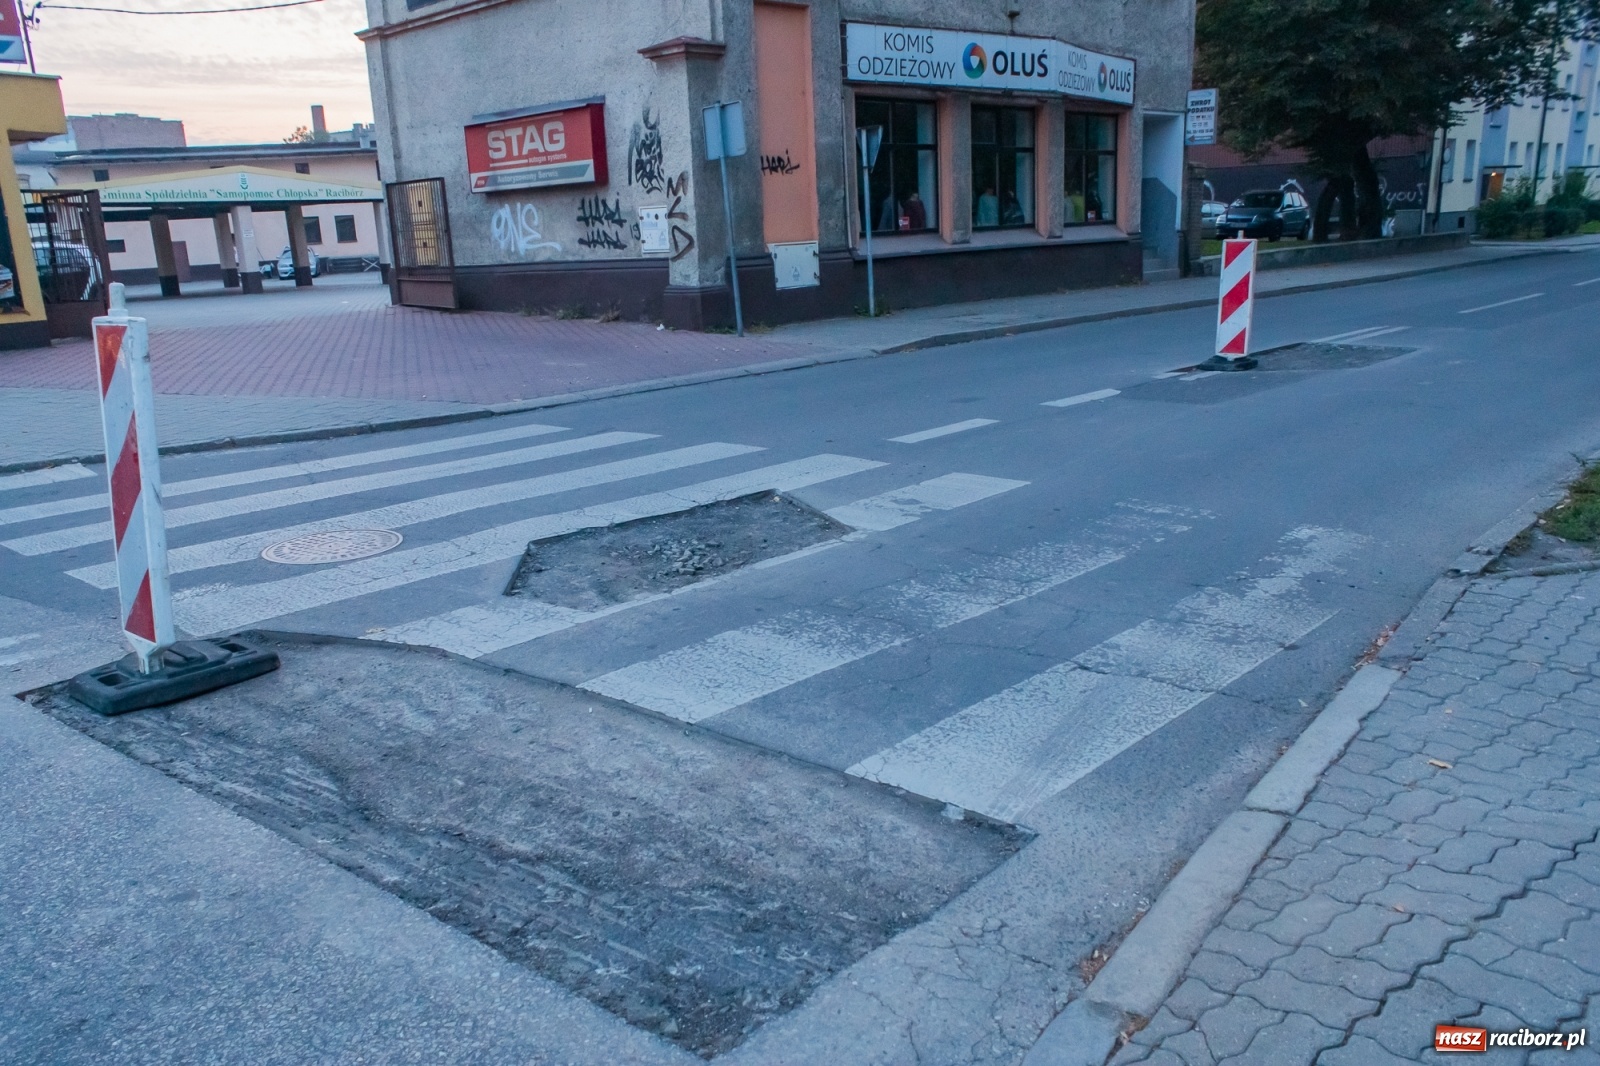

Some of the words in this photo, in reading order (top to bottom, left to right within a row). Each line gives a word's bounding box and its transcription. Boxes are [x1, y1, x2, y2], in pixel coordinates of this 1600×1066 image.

[884, 32, 934, 54] KOMIS
[857, 55, 956, 79] ODZIEŻOWY
[992, 49, 1049, 77] OLUŚ
[1067, 50, 1088, 70] KOMIS
[1058, 70, 1096, 93] ODZIEŻOWY
[1109, 68, 1132, 93] OLUŚ
[487, 121, 565, 159] STAG
[547, 152, 567, 161] systems
[538, 170, 558, 179] Serwis
[145, 189, 208, 201] Spółdzielnia
[325, 188, 364, 198] Racibórz
